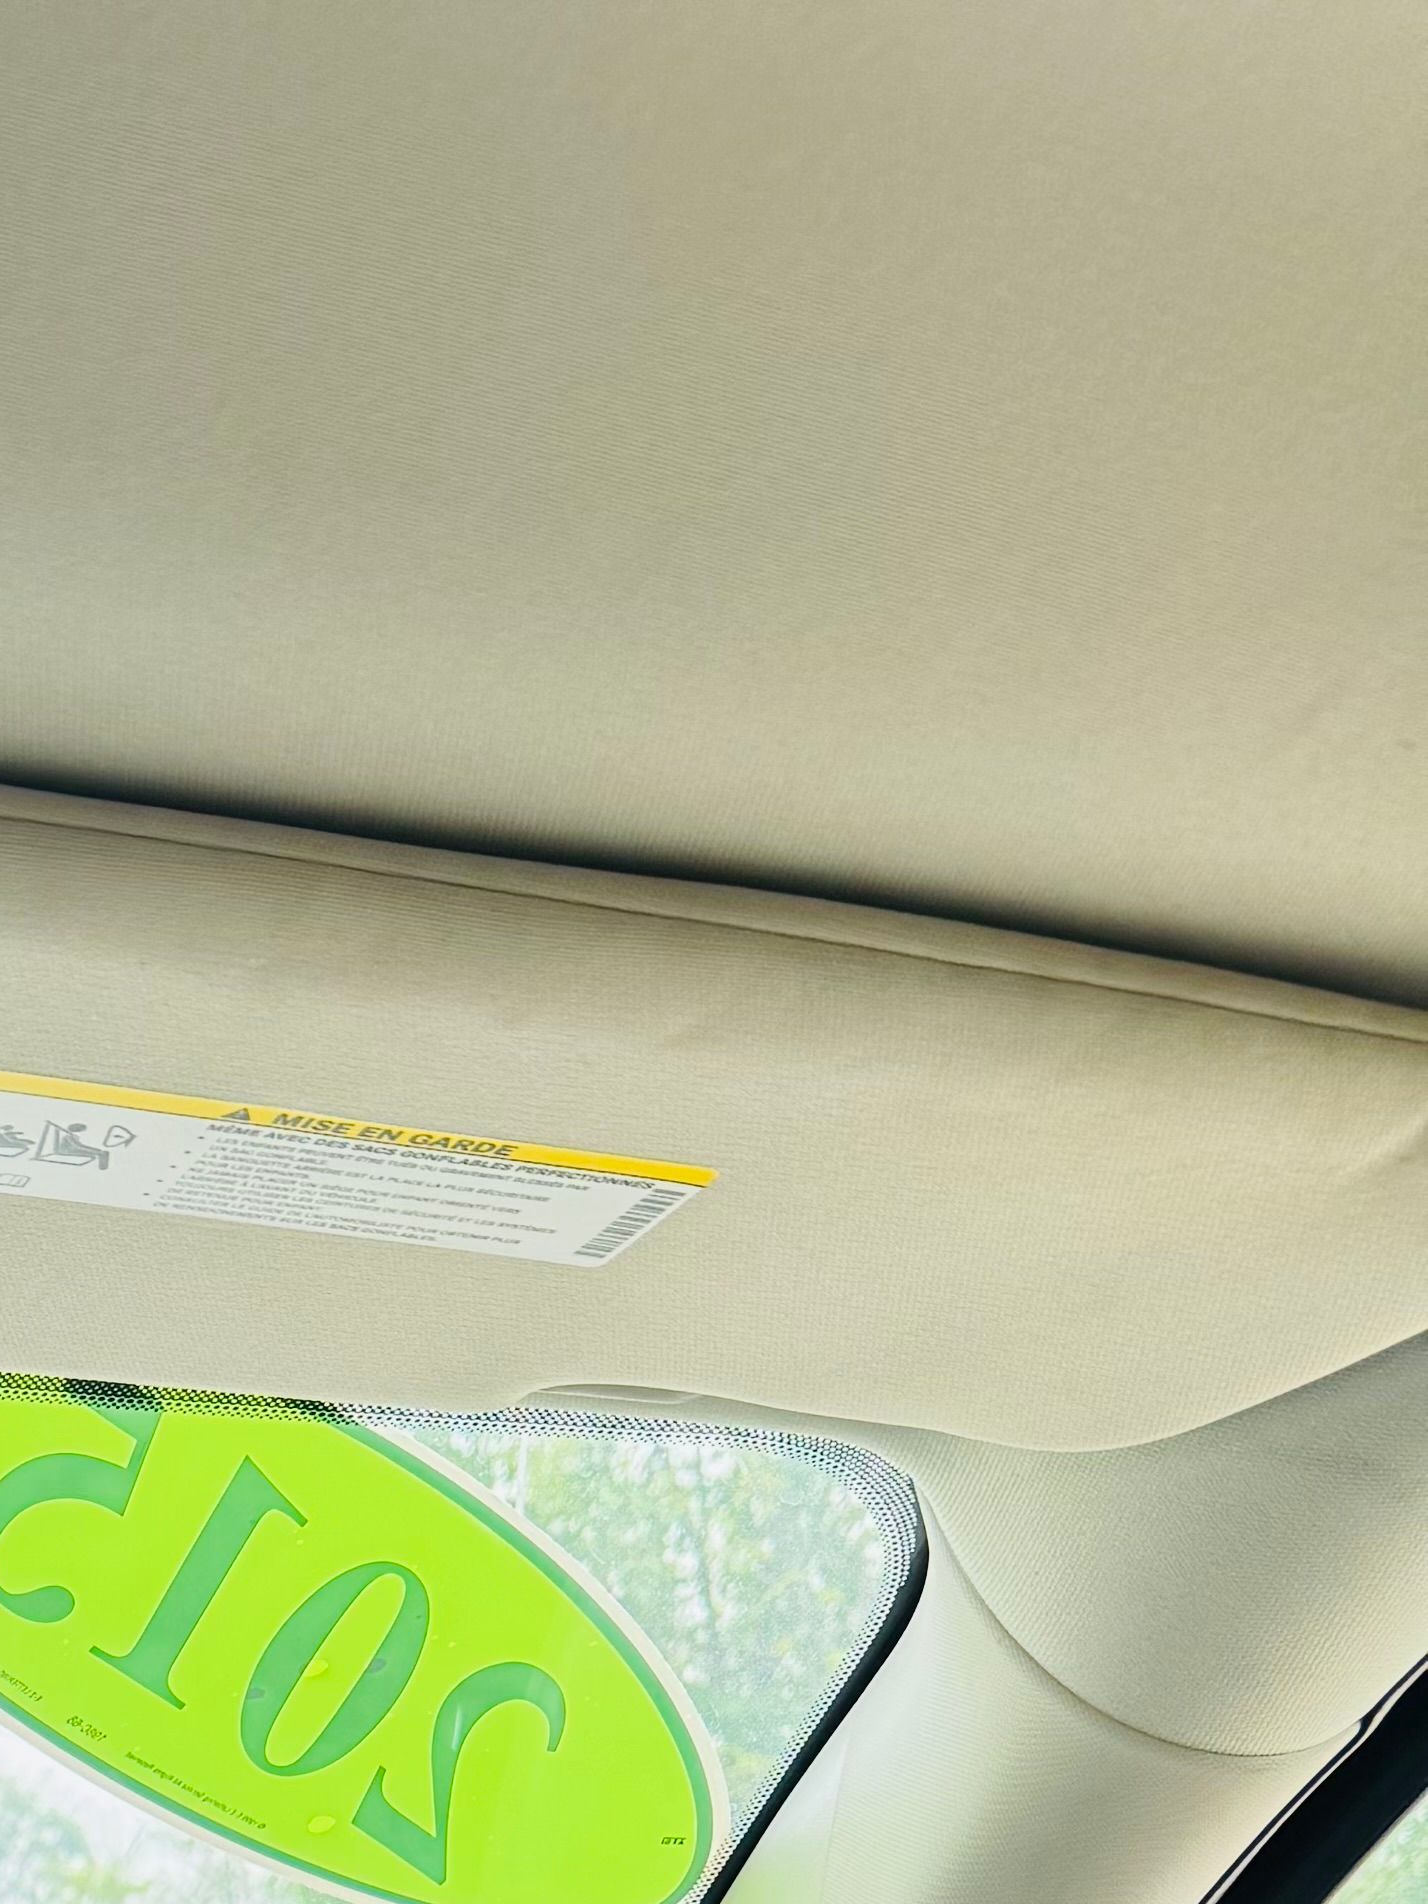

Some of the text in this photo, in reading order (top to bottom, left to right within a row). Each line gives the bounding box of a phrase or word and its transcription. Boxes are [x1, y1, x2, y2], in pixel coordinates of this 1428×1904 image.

[270, 1112, 519, 1157] MISE EN GARDE
